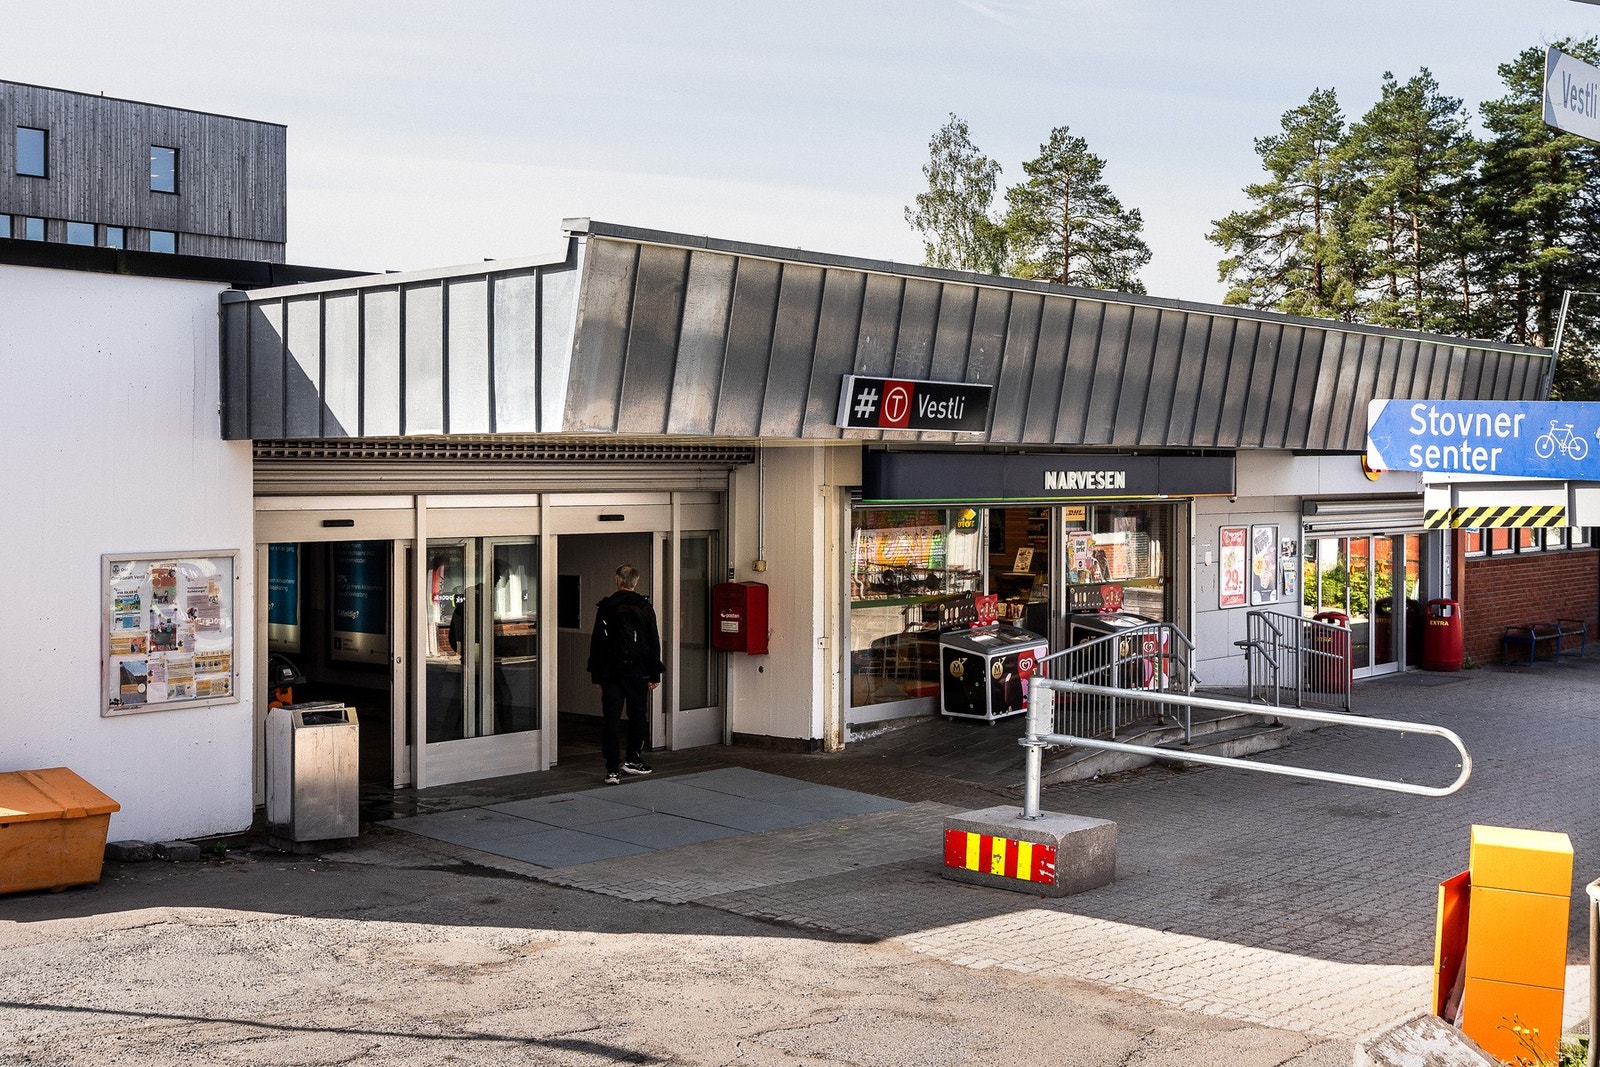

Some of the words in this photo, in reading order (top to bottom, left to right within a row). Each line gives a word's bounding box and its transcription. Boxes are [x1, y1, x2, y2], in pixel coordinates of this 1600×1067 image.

[1562, 71, 1598, 119] Vestli
[918, 393, 965, 420] Vestli
[1409, 403, 1526, 438] Stovner
[1408, 440, 1503, 472] senter
[1044, 471, 1125, 490] NARVESEN
